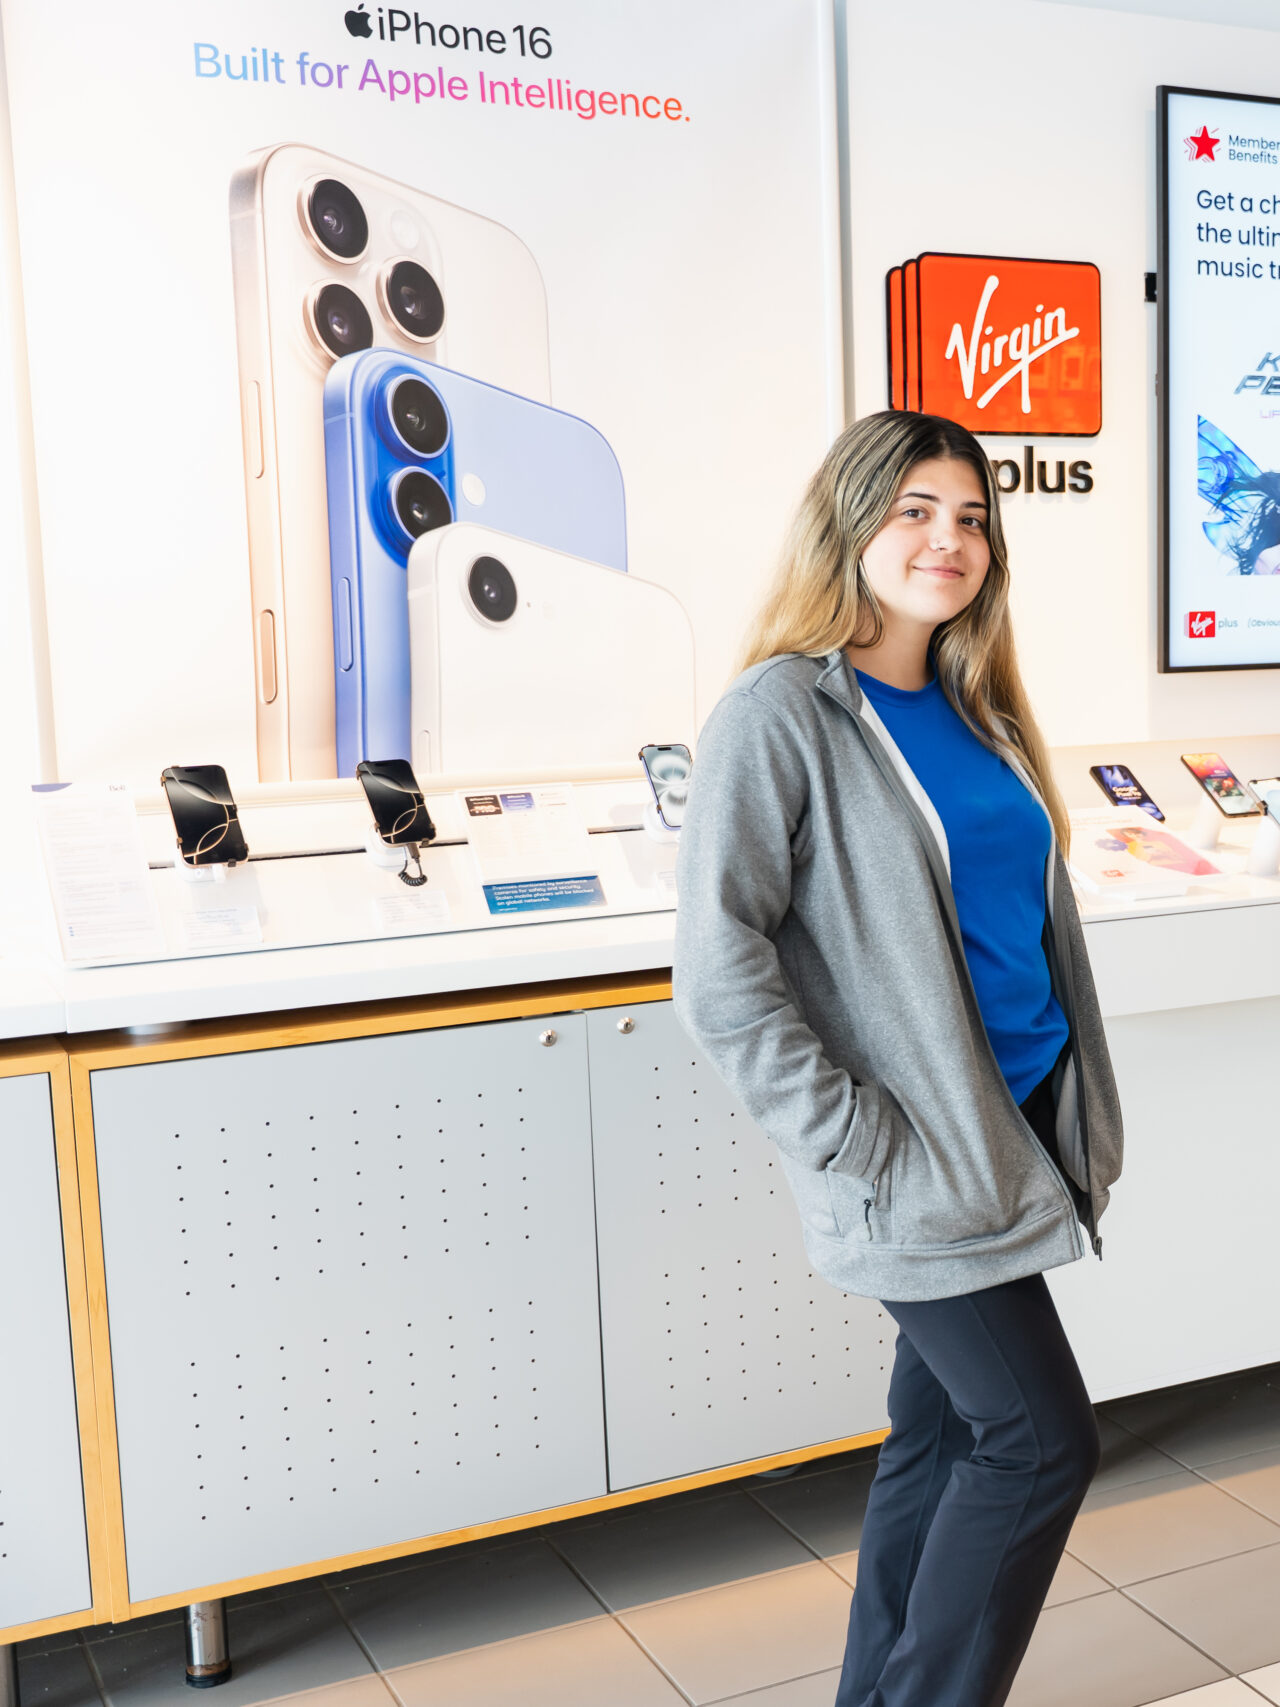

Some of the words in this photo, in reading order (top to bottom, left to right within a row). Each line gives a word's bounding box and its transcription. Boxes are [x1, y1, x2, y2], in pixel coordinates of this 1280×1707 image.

[377, 7, 507, 56] iPhone
[513, 24, 555, 60] 16
[192, 42, 286, 85] Built
[296, 51, 350, 91] for
[358, 58, 470, 105] Apple
[479, 70, 693, 124] Intelligence.
[1228, 148, 1279, 166] Benefits
[1196, 190, 1235, 213] Get
[1239, 195, 1255, 214] a
[1196, 223, 1233, 245] the
[1196, 255, 1263, 281] music
[945, 275, 1080, 414] Virgin
[1218, 617, 1238, 629] plus
